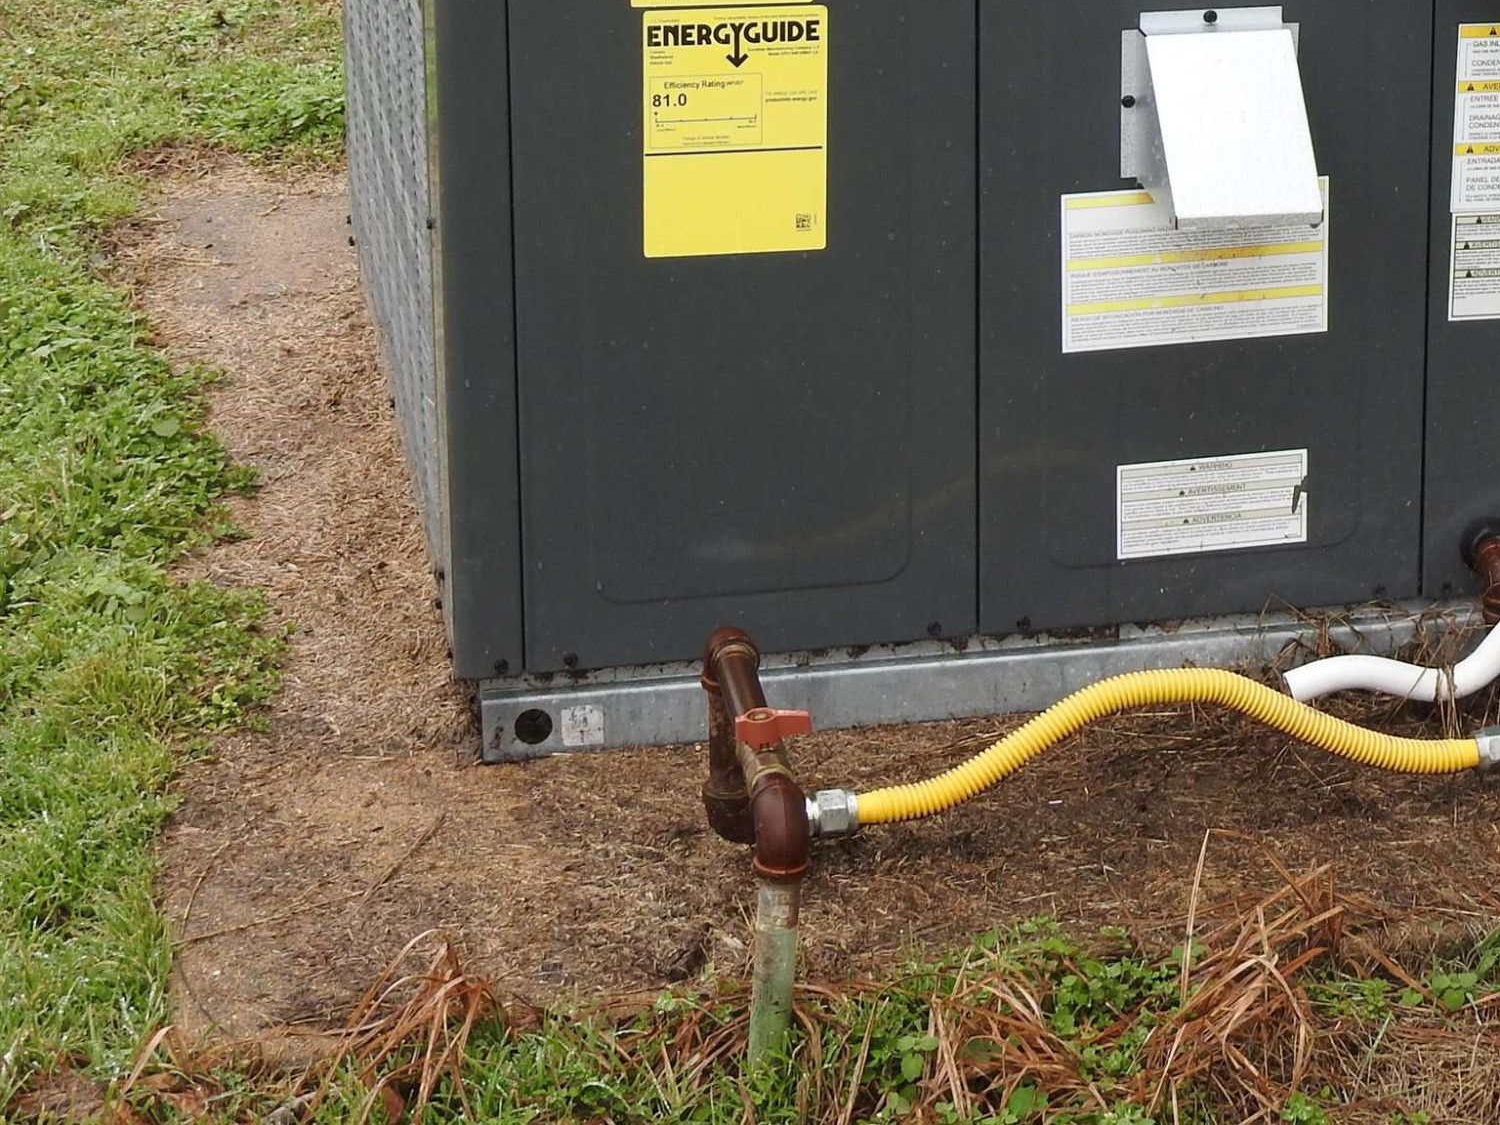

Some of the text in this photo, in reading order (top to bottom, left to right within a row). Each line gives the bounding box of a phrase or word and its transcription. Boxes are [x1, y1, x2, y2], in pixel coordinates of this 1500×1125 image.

[646, 20, 820, 47] ENERGYGUIDE
[664, 81, 700, 90] Efficiency
[701, 79, 725, 89] Rating
[652, 93, 687, 108] 81.0
[1467, 157, 1500, 165] ENTRADA
